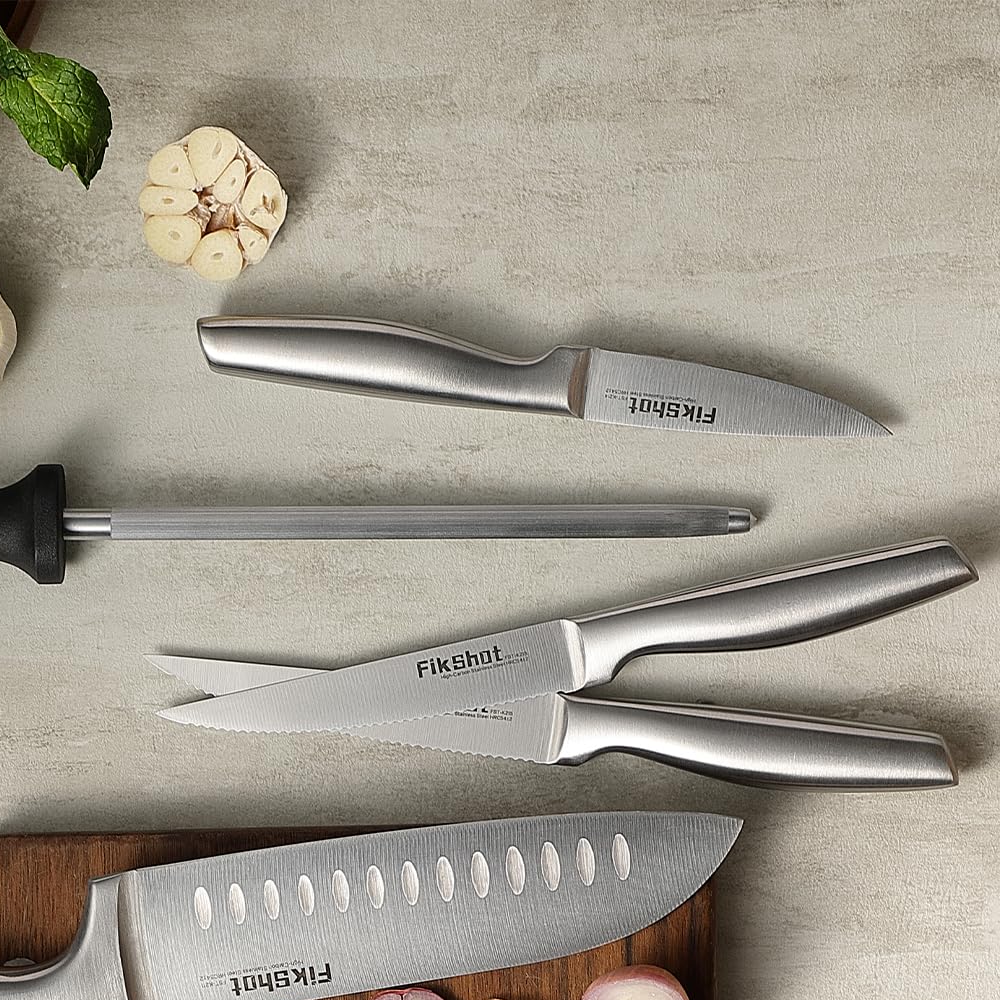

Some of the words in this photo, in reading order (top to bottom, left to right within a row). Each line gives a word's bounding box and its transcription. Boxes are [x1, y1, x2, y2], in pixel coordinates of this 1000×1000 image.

[628, 396, 716, 424] FikShot
[416, 644, 503, 678] FikShot
[229, 962, 332, 996] FikShot
